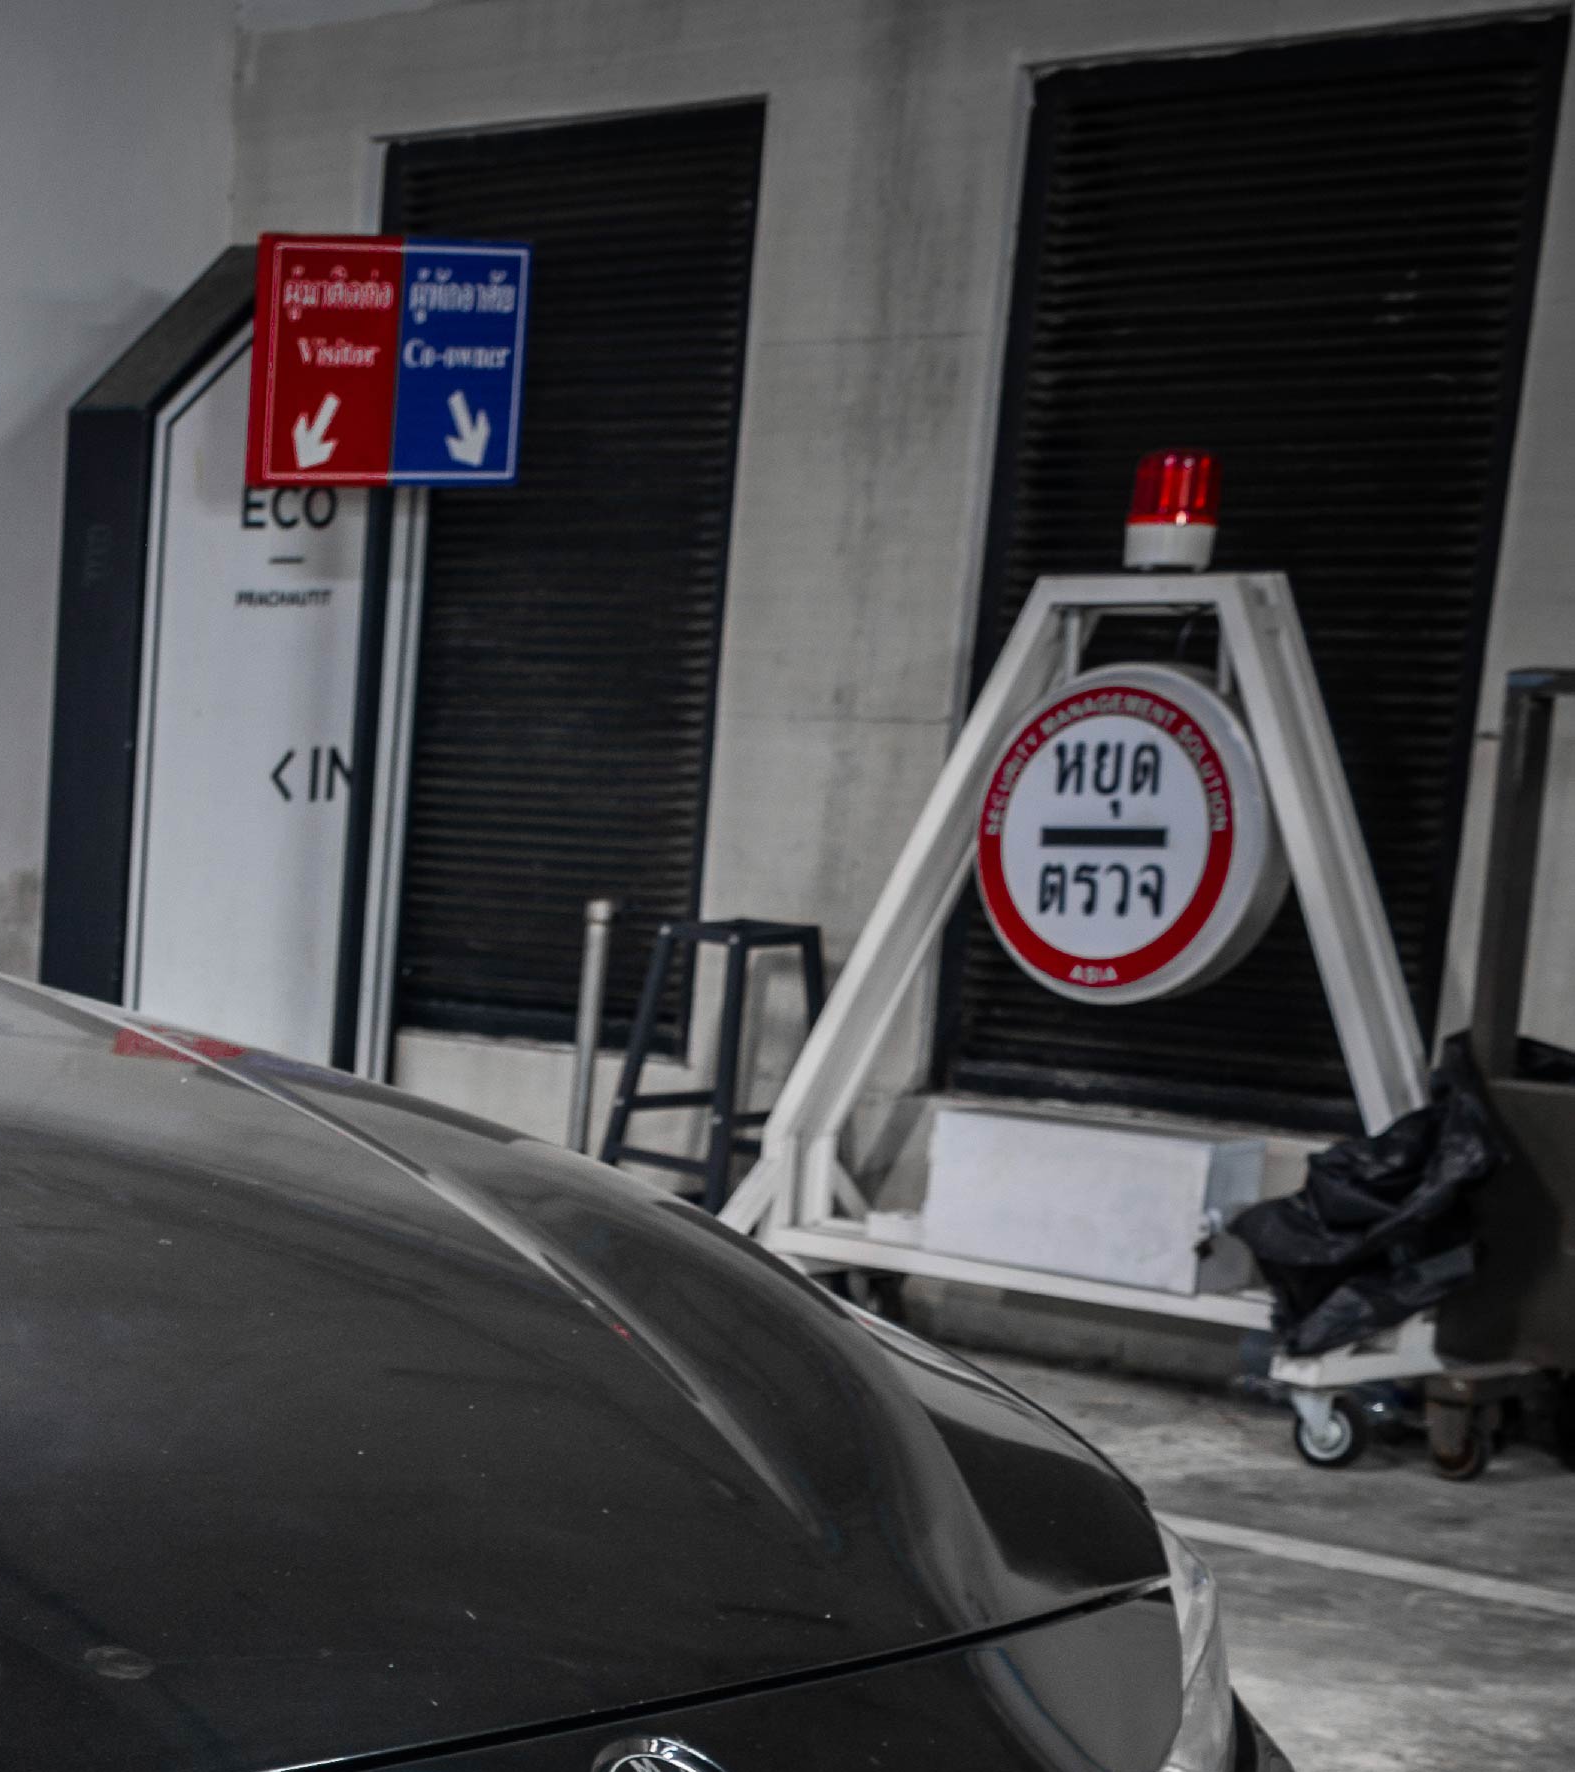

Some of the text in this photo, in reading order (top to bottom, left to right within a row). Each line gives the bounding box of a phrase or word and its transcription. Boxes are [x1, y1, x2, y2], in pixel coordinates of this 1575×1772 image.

[298, 337, 381, 368] Visitor
[402, 337, 511, 369] Co-owner
[241, 487, 337, 529] ECO
[1039, 692, 1178, 736] MANAGEMENT
[1177, 723, 1229, 832] SOLUTION
[1054, 740, 1163, 819] หยุด
[1037, 862, 1167, 918] ตรวจ
[1068, 964, 1118, 984] ASIA
